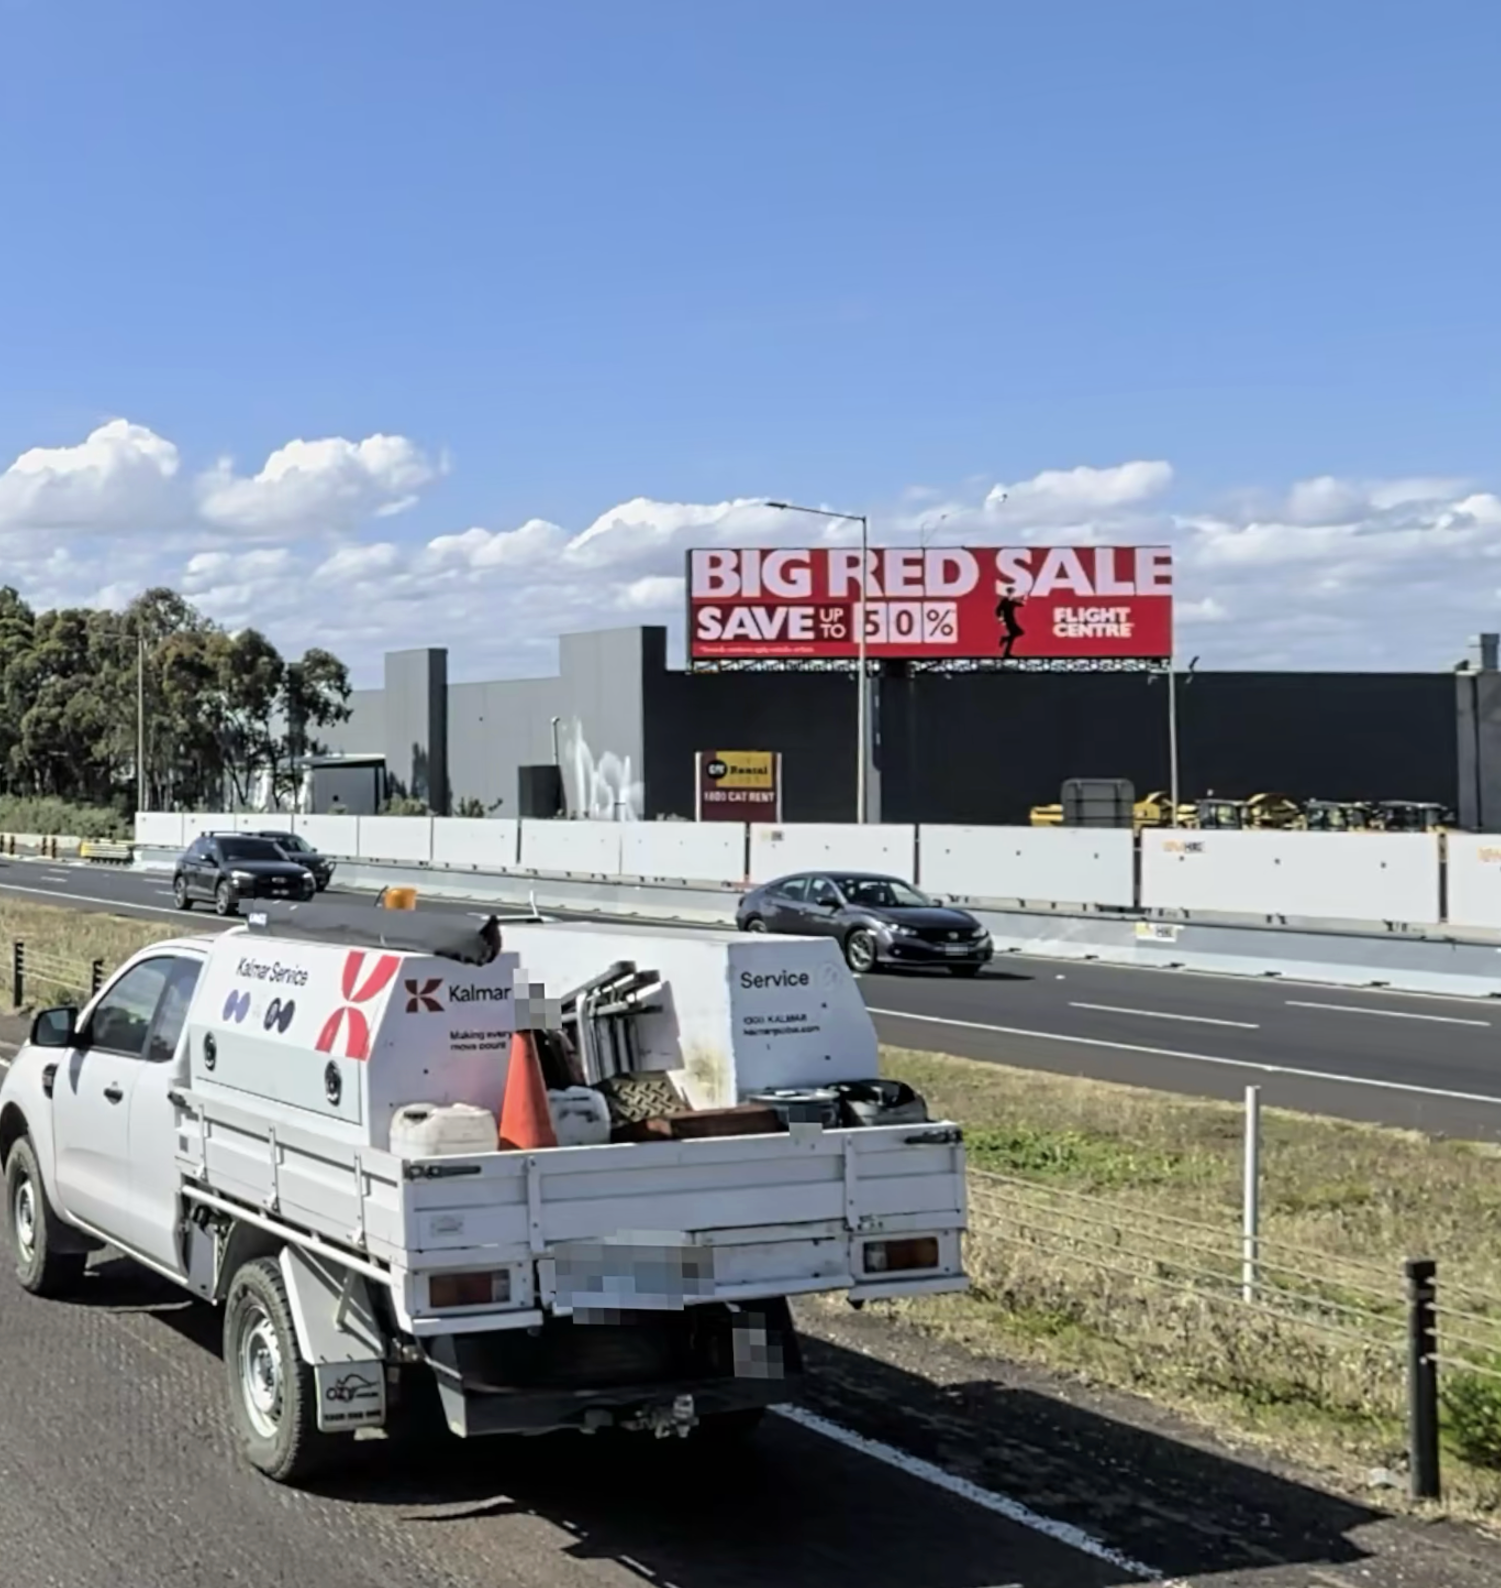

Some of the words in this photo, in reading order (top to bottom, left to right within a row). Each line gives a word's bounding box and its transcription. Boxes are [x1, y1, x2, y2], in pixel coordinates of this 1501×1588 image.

[692, 549, 813, 598] BIG
[828, 548, 980, 597] RED
[995, 547, 1173, 597] SALE
[820, 608, 844, 623] UP
[862, 608, 955, 637] 50%
[1053, 606, 1131, 623] FLIGHT
[697, 606, 815, 640] SAVE
[1052, 622, 1133, 638] CENTRE
[820, 624, 846, 639] TO
[729, 765, 768, 775] Rental
[728, 791, 747, 803] CAT
[748, 791, 775, 803] RENT
[236, 957, 271, 980] Kalmar
[269, 961, 309, 986] Service
[740, 969, 810, 989] Service
[449, 984, 512, 1002] Kalmar
[450, 1030, 486, 1041] Making
[486, 1030, 512, 1040] every
[450, 1041, 477, 1051] move
